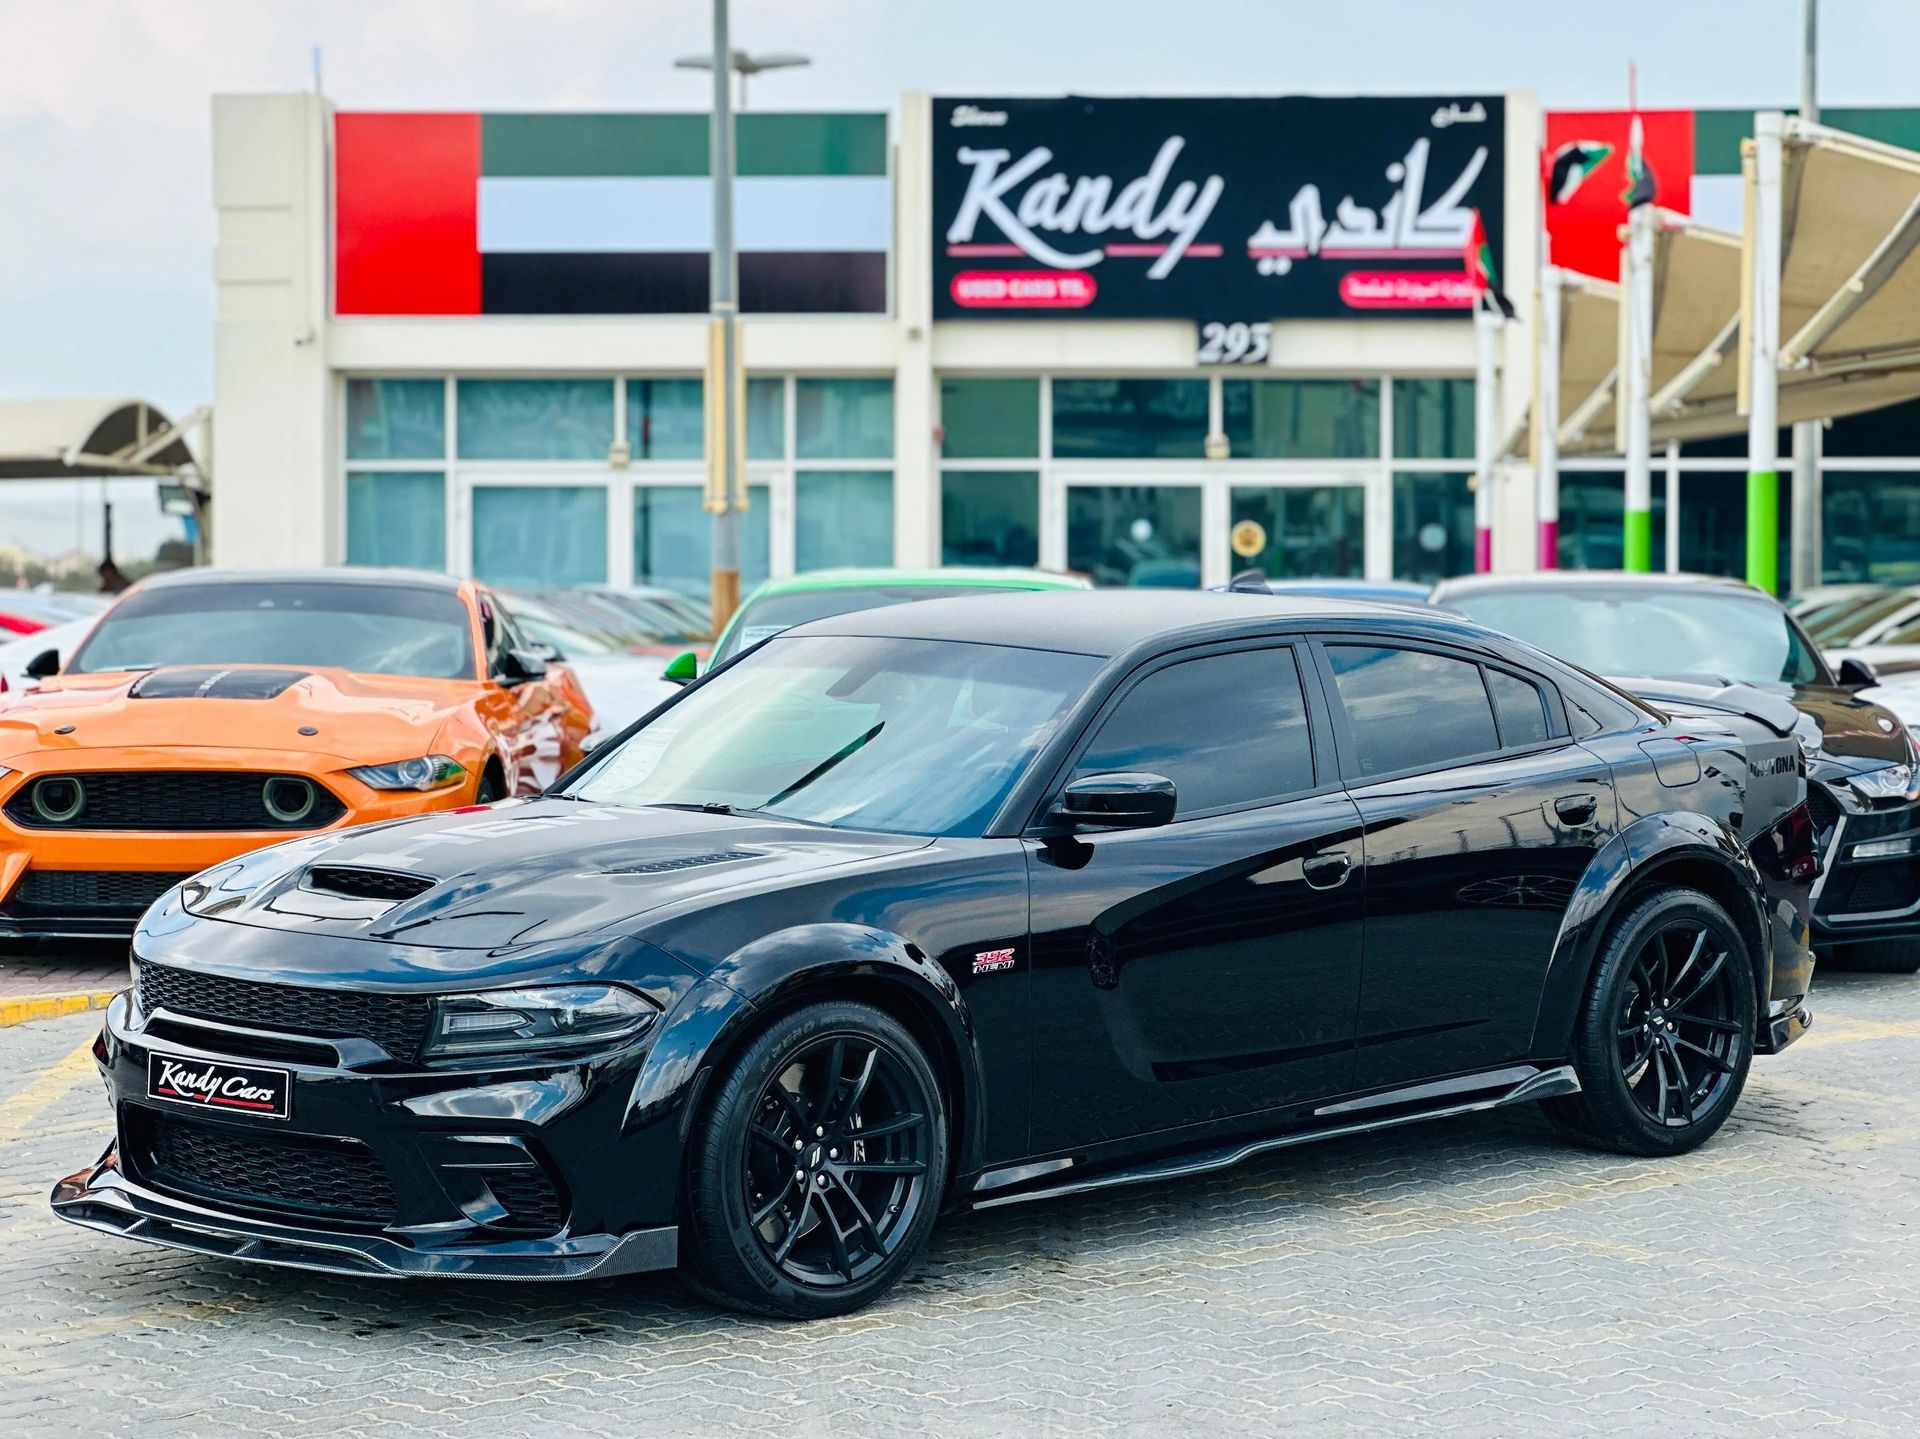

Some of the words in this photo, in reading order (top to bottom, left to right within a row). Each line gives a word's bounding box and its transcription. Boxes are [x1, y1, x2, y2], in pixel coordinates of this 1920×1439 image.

[947, 135, 1224, 279] Kandy
[1247, 135, 1489, 276] كاندي
[1198, 321, 1272, 364] 295
[975, 947, 1016, 966] 392
[158, 1060, 223, 1103] Kandy
[221, 1076, 275, 1101] Cars
